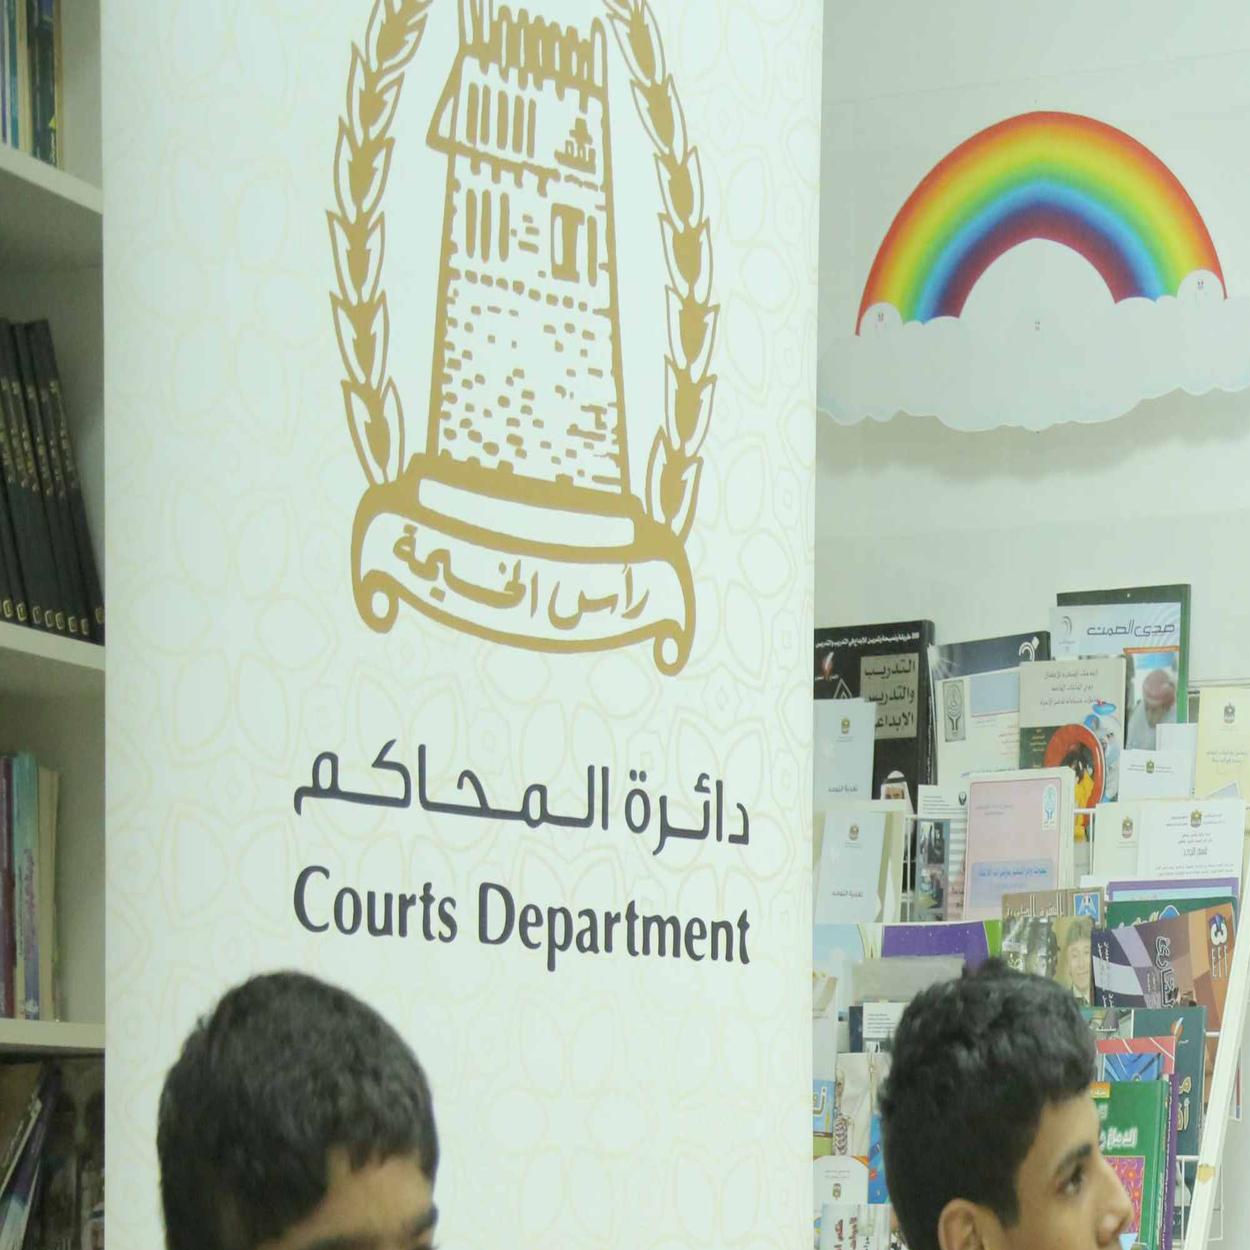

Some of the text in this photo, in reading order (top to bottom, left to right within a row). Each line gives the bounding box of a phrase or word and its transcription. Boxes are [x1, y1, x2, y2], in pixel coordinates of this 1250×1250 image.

[392, 523, 539, 619] الخيمة
[293, 738, 751, 856] دائرة المحاكم
[293, 864, 751, 973] Courts Department
